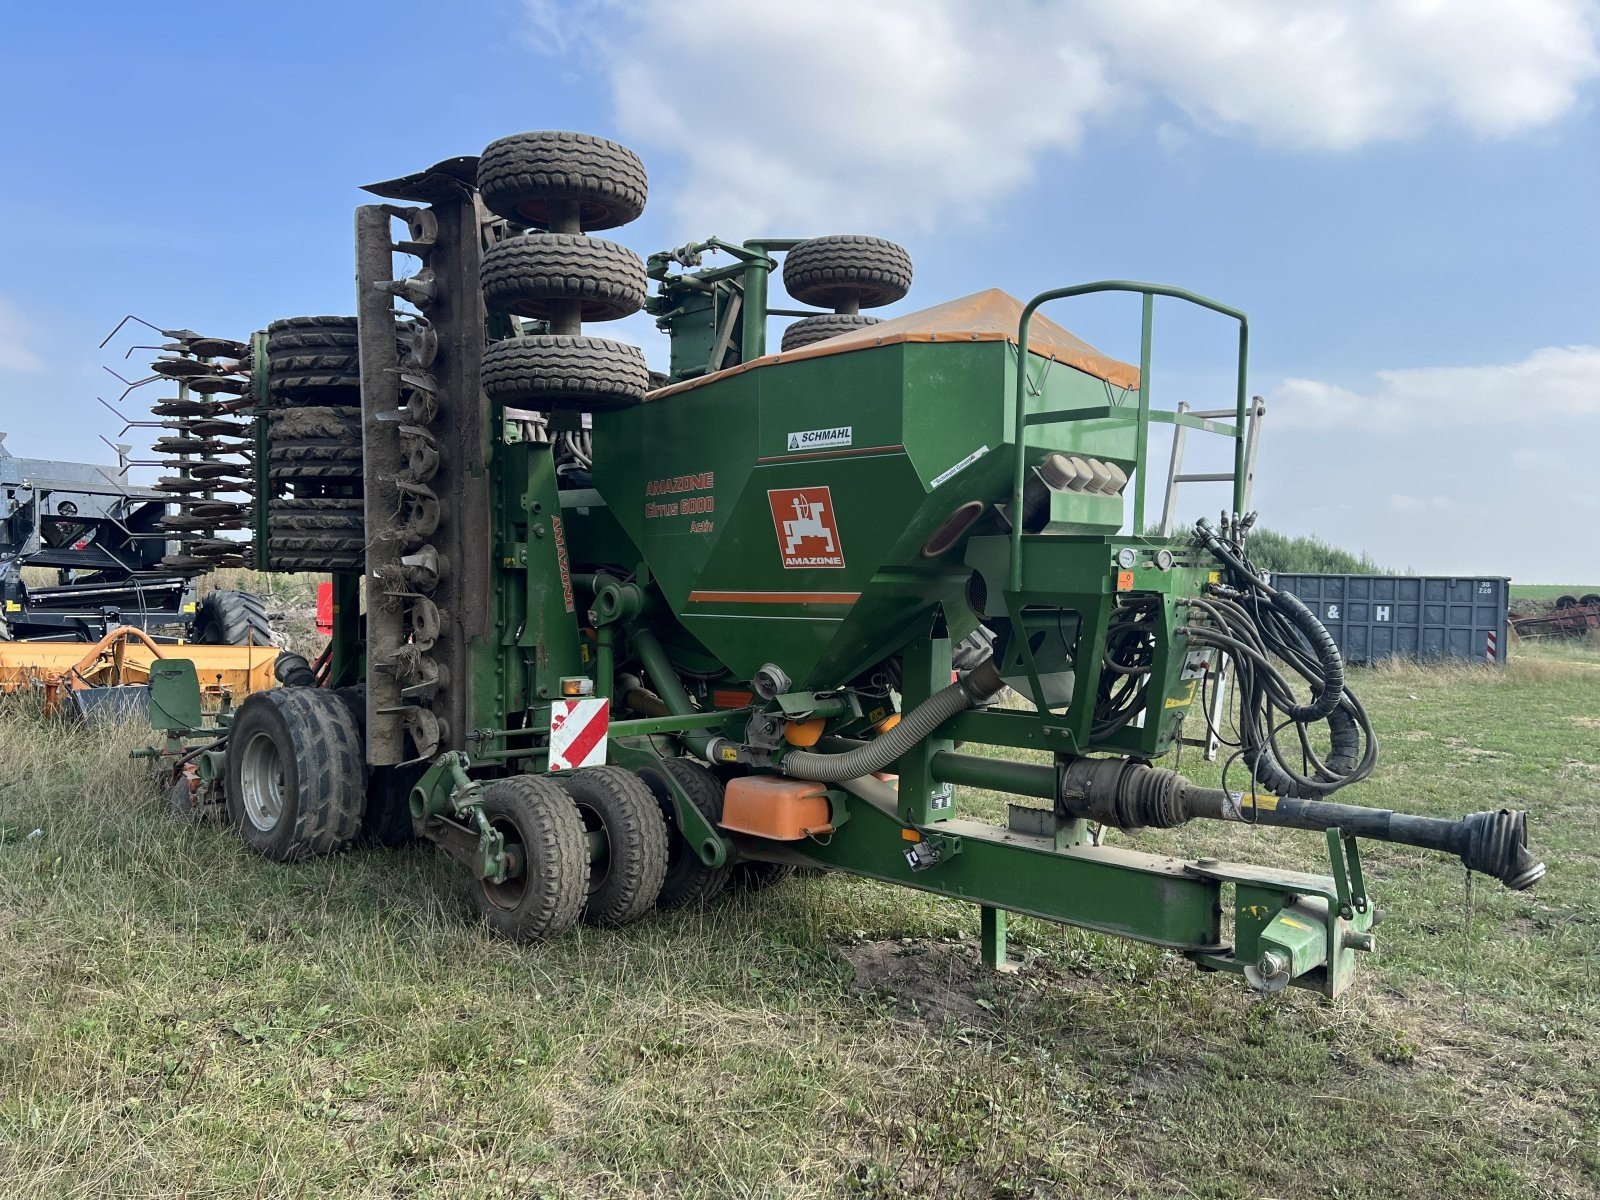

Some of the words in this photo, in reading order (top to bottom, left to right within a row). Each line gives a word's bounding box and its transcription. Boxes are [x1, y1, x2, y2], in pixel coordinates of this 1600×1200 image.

[801, 428, 850, 442] SCHMAHL
[646, 472, 714, 496] AMAZONE
[646, 502, 678, 518] Cirrus
[681, 496, 714, 514] 6000
[690, 520, 714, 533] Activ
[551, 514, 575, 613] AMAZONE
[785, 557, 842, 565] AMAZONE
[1327, 604, 1340, 619] &
[1376, 606, 1390, 621] H
